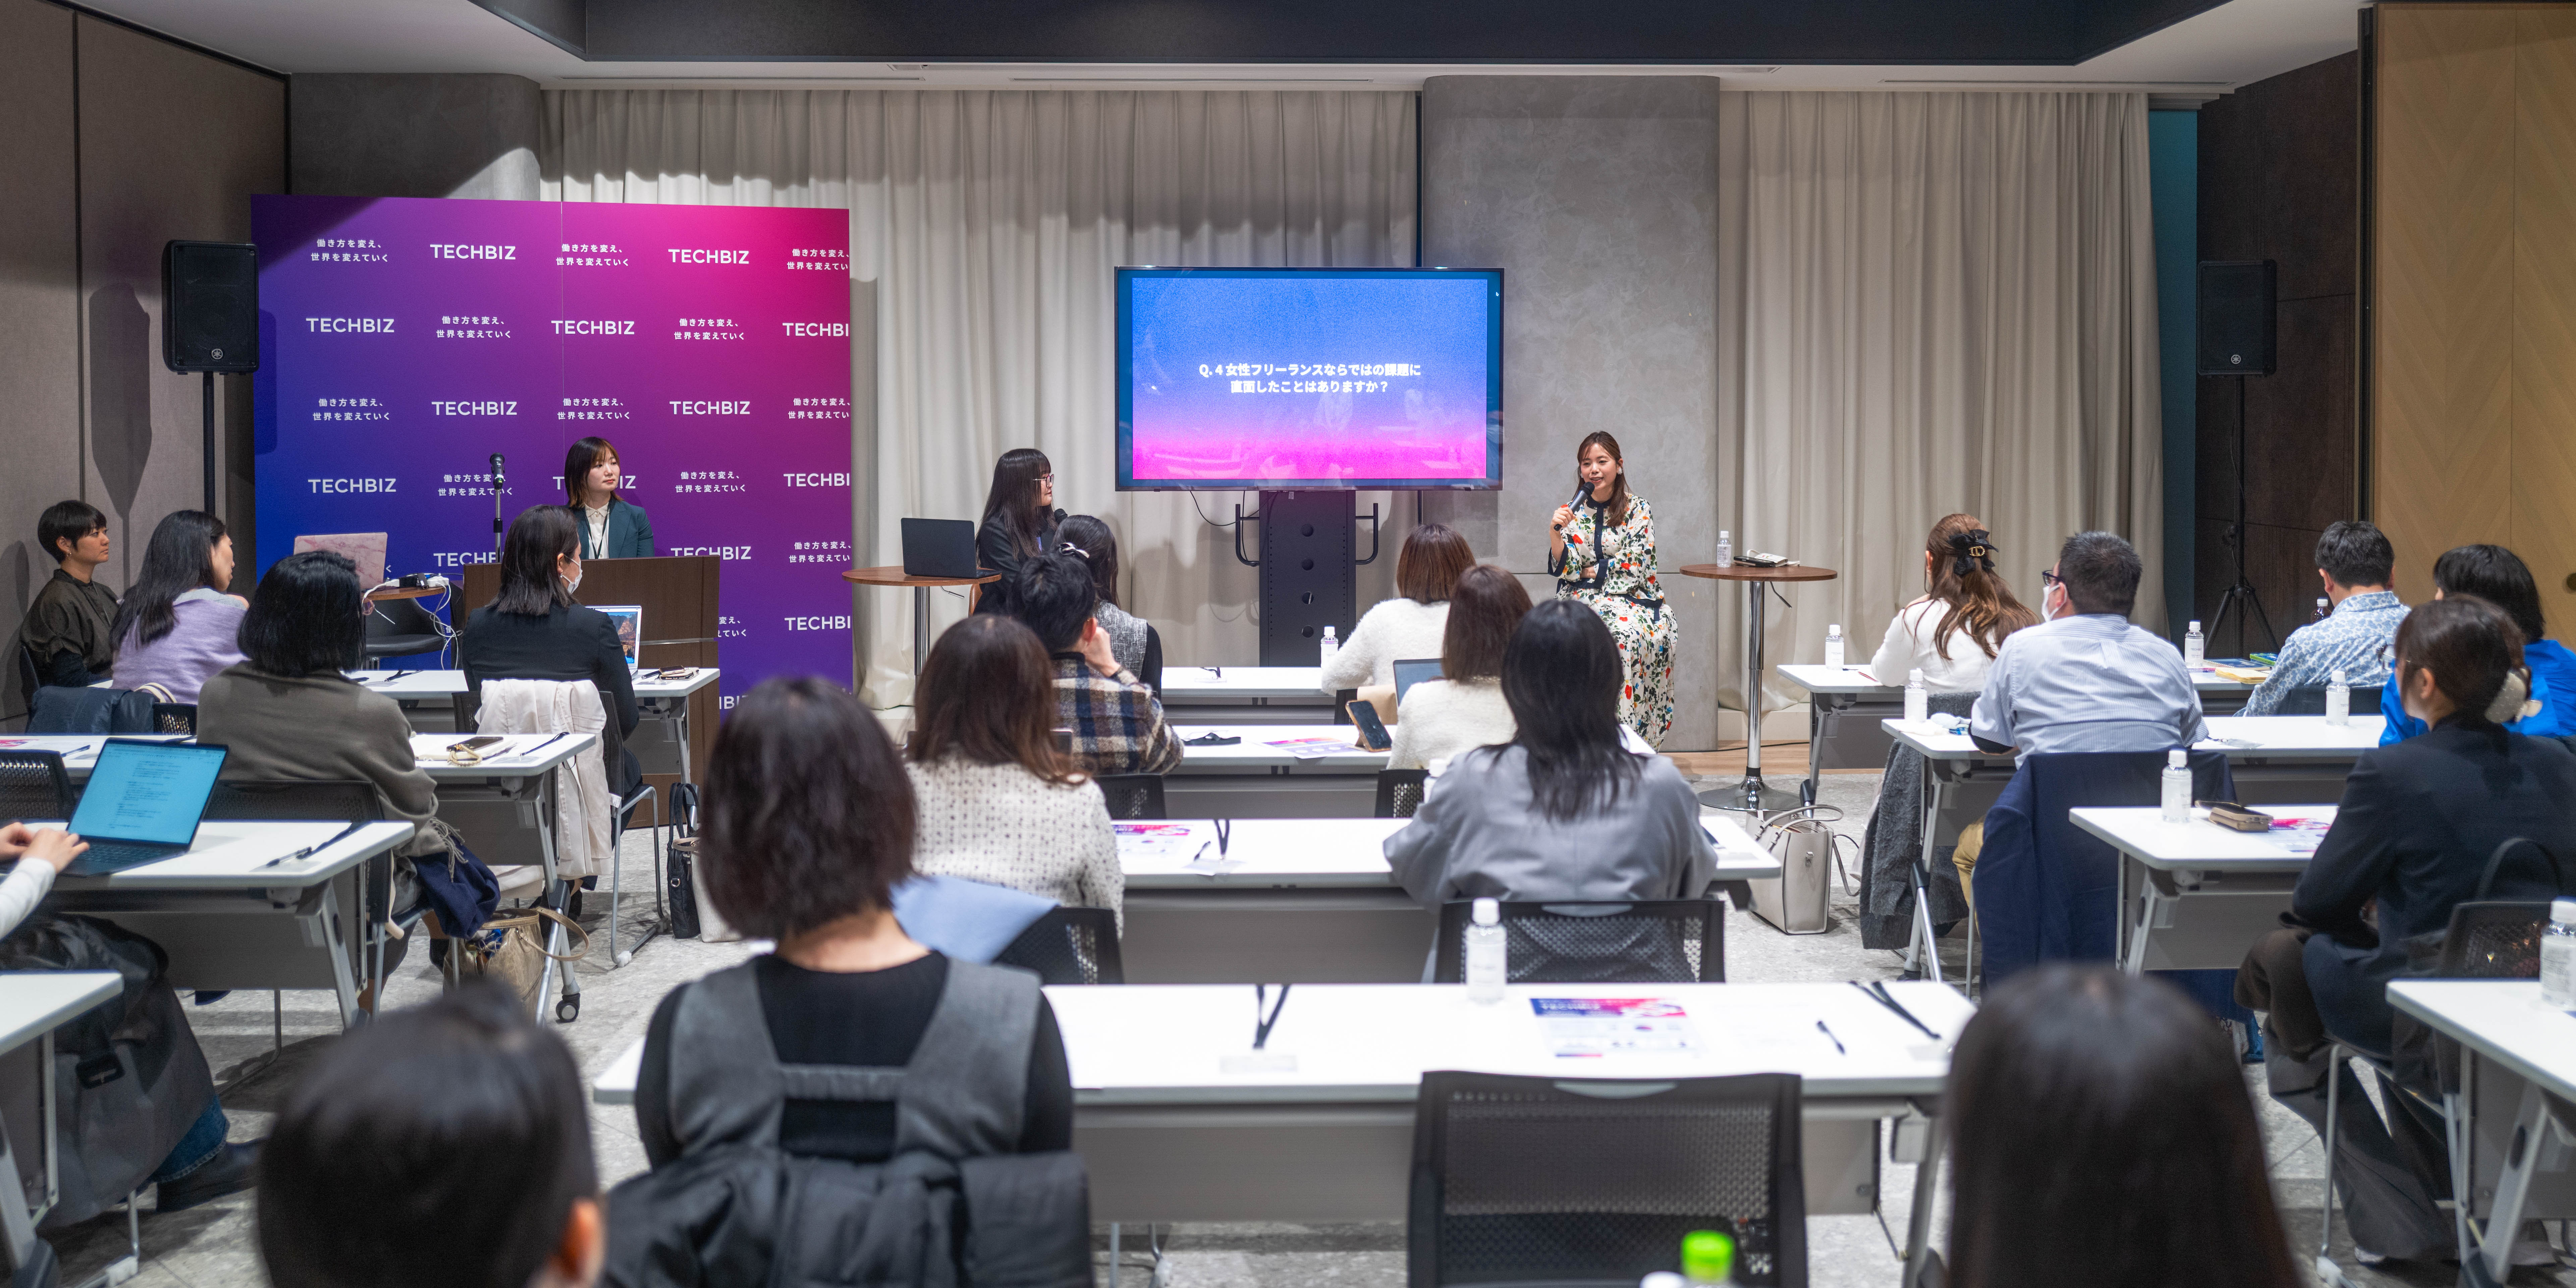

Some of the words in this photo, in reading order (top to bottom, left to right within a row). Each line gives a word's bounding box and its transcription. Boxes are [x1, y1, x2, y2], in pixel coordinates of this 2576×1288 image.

[317, 239, 381, 248] 働き方を変え、
[562, 243, 622, 253] 働き方を変え、
[430, 244, 516, 260] TECHBIZ
[668, 249, 749, 264] TECHBIZ
[792, 248, 849, 258] 働き方を変え、
[311, 253, 388, 262] 世界を変えていく
[556, 257, 628, 266] 世界を変えていく
[787, 262, 848, 270] 世界を変えてい
[442, 316, 504, 325] 働き方を変え、
[679, 318, 738, 327] 働き方を変え、
[306, 318, 394, 333] TECHBIZ
[551, 320, 634, 335] TECHBIZ
[782, 323, 849, 337] TECHBI
[436, 330, 510, 338] 世界を変えていく
[674, 331, 744, 340] 世界を変えていく
[1230, 380, 1388, 393] 直面したことはありますか？
[319, 398, 383, 407] 働き方を変え、
[563, 398, 623, 406] 働き方を変え、
[793, 398, 850, 406] 働き方を変え、
[431, 401, 517, 415] TECHBIZ
[669, 401, 750, 415] TECHBIZ
[313, 412, 389, 421] 世界を変えていく
[557, 411, 629, 420] 世界を変えていく
[788, 411, 849, 419] 世界を変えてい
[444, 474, 506, 483] 働き方を変、
[680, 471, 739, 480] 働き方を変え、
[783, 473, 850, 487] TECHBI
[308, 478, 396, 493] TECHBIZ
[675, 484, 745, 493] 世界を変えていく
[794, 541, 851, 550] 働き方を変え、
[789, 554, 850, 563] 世界を変えてい
[784, 616, 850, 631] TECHBI
